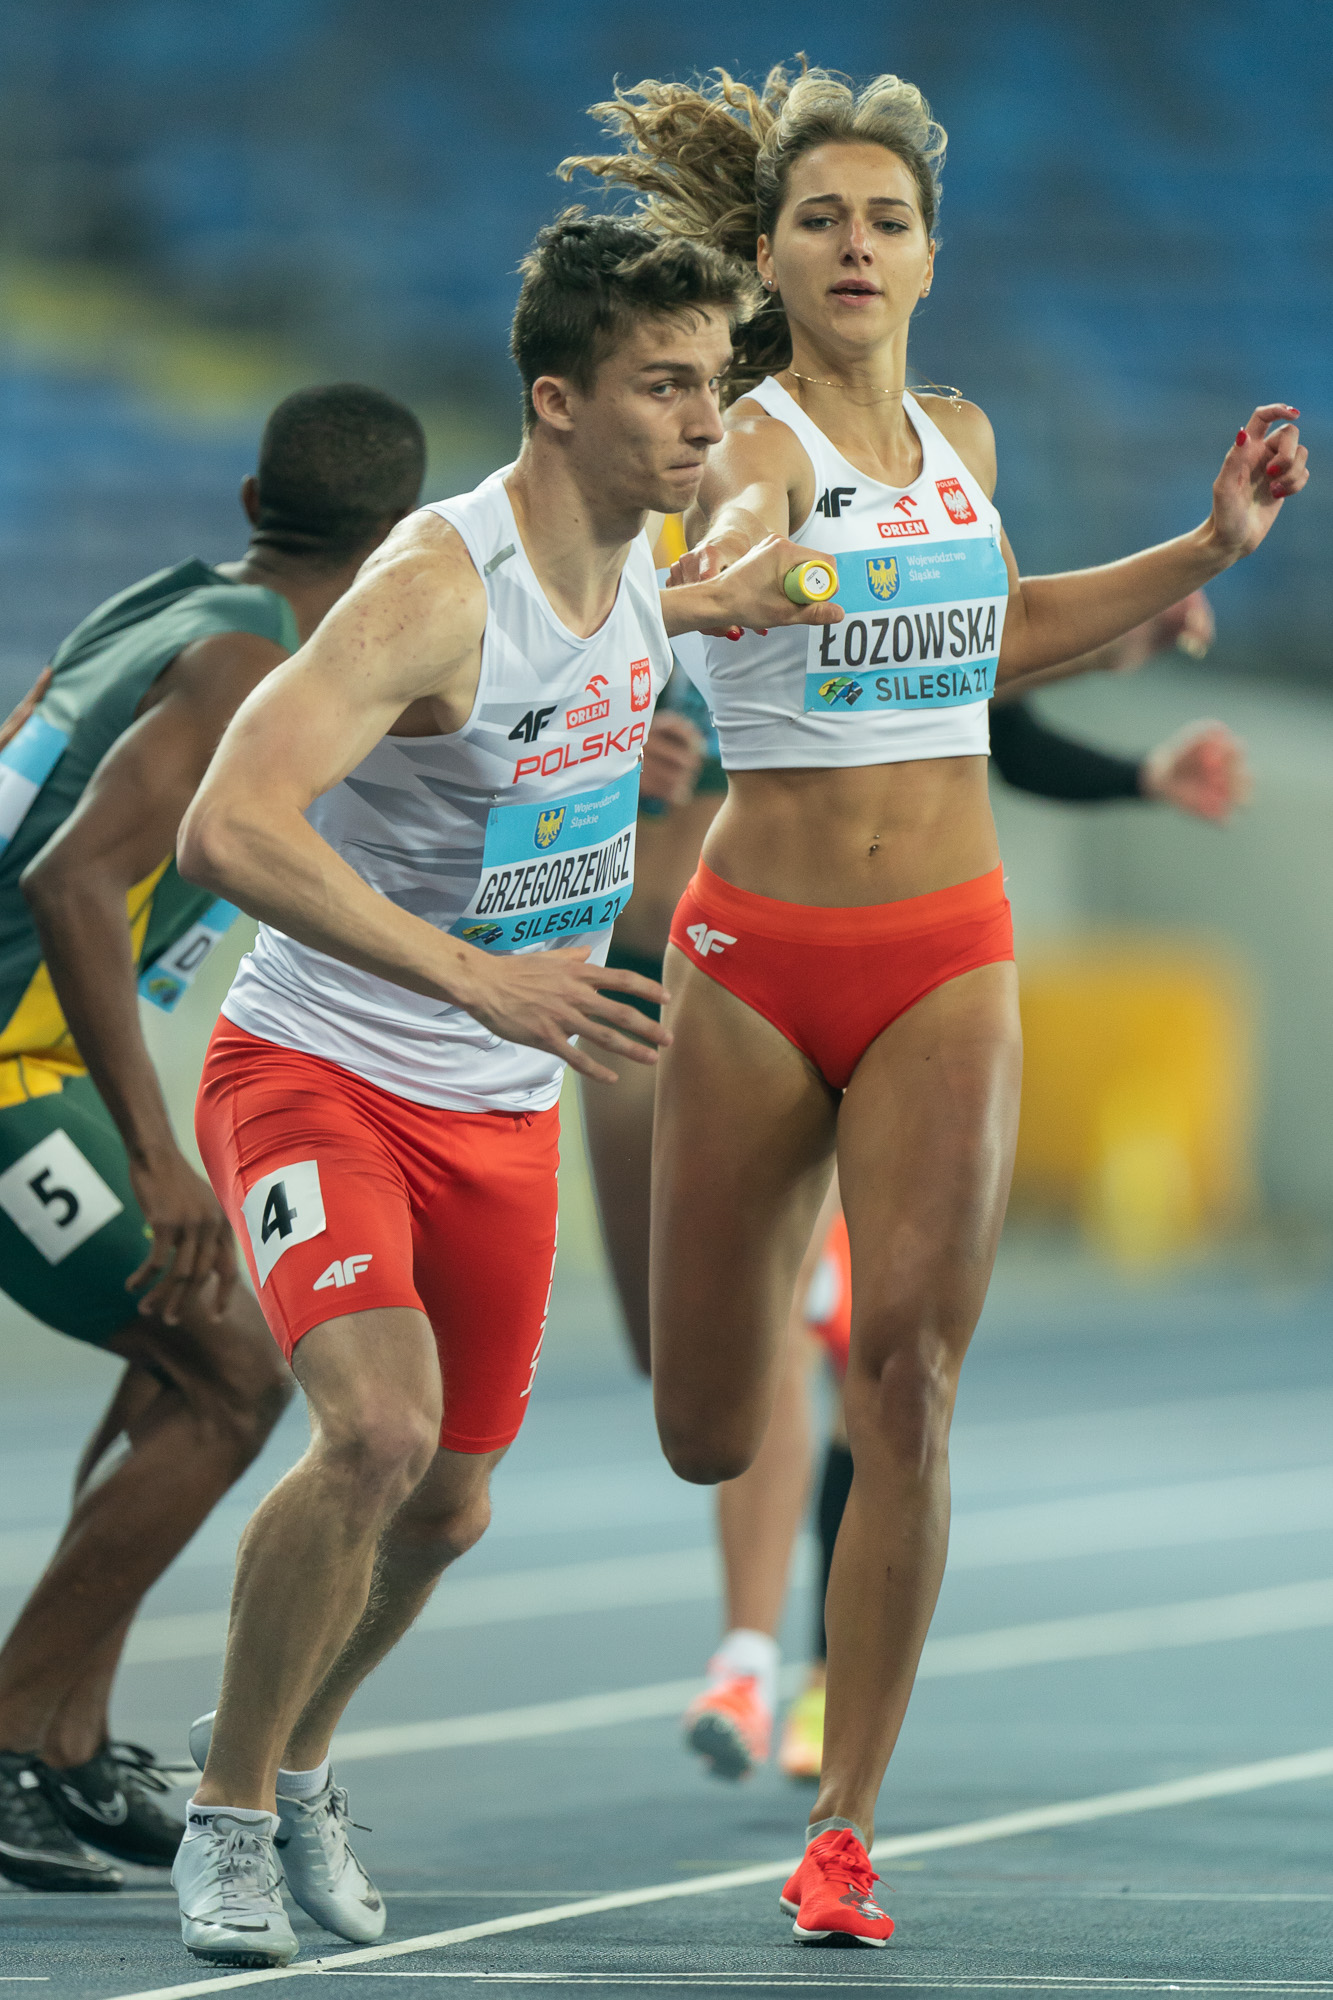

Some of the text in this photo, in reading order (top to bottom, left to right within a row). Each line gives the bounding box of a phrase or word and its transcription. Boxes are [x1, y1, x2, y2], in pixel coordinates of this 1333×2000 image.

[880, 521, 926, 537] ORLEN
[819, 605, 996, 667] ŁOZOWSKA
[568, 702, 608, 727] ORLEN
[875, 666, 987, 702] SILESIA 21
[512, 722, 645, 784] POLSKA
[475, 832, 631, 915] GRZEGORZEWICZ
[511, 896, 621, 942] SILESIA 21
[28, 1167, 79, 1228] 5
[261, 1180, 297, 1245] 4
